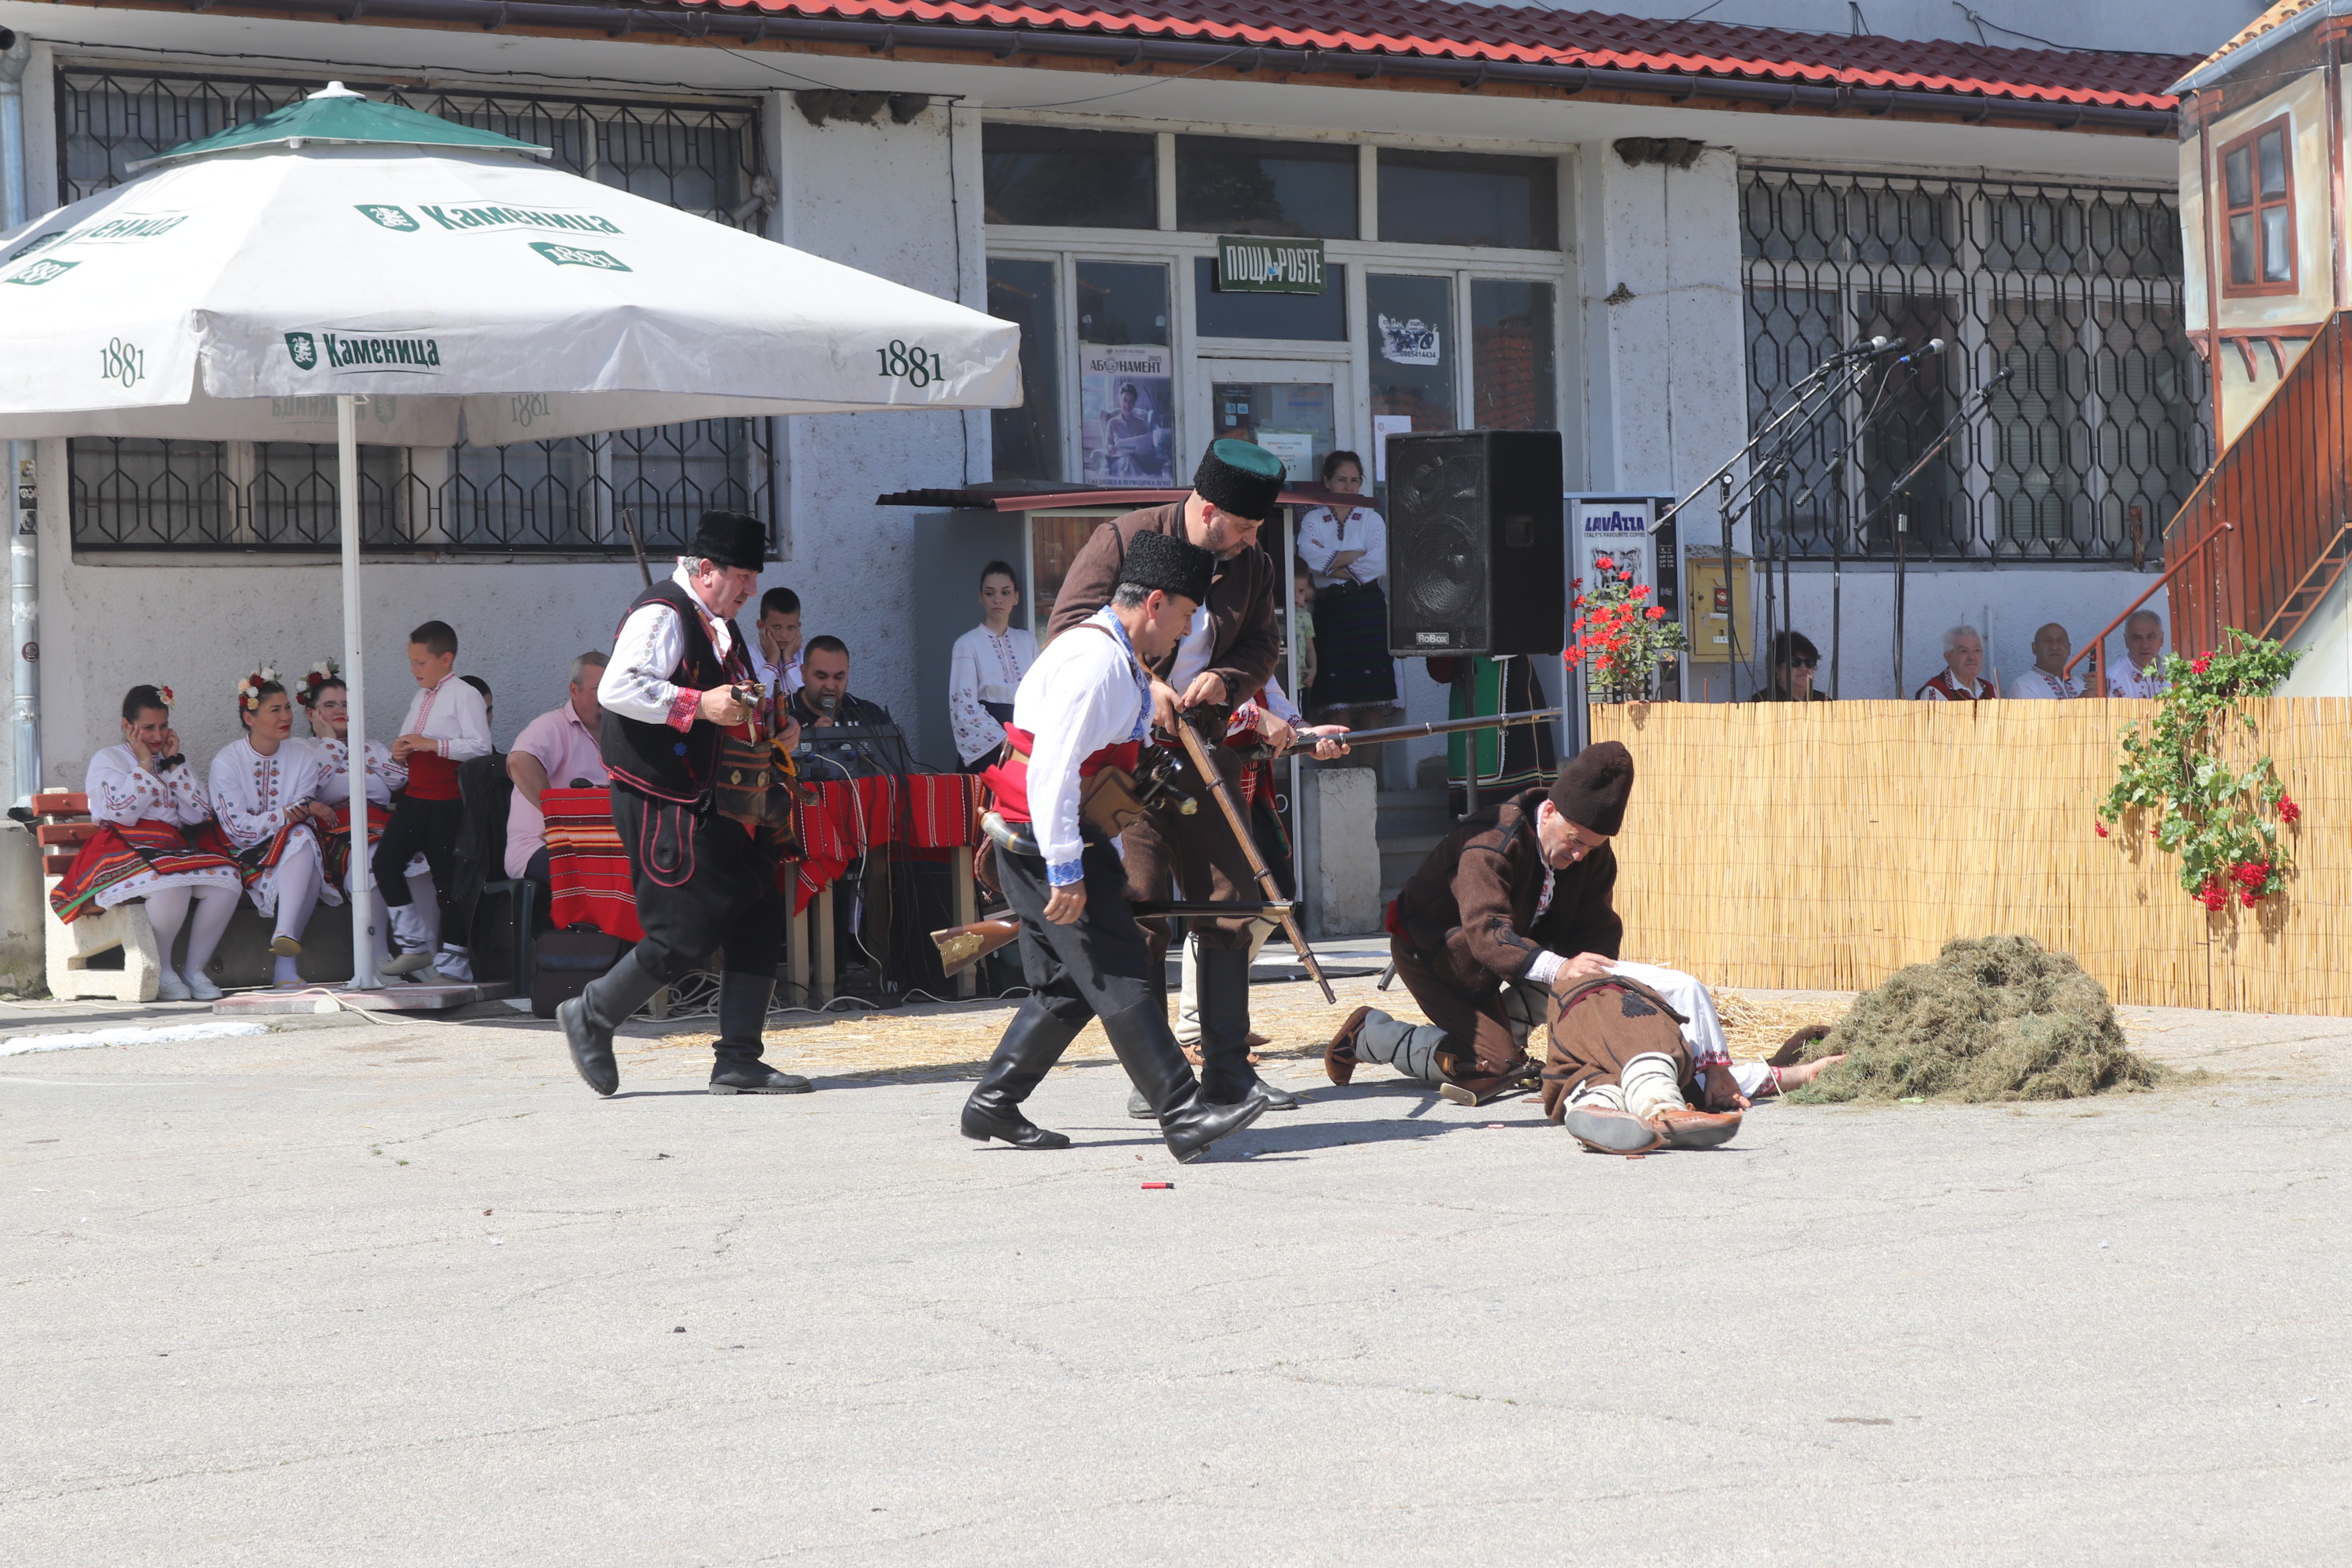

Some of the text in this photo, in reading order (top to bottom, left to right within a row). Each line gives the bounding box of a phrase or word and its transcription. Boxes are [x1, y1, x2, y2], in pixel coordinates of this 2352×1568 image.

[416, 205, 625, 235] Каменица
[544, 246, 624, 268] 1881
[100, 337, 145, 388] 1881
[322, 333, 441, 370] Каменица
[876, 339, 945, 388] 1881
[1091, 357, 1162, 374] АБОНАМЕНТ
[1585, 511, 1645, 531] LAVAZZA
[1418, 634, 1448, 643] RoBox
